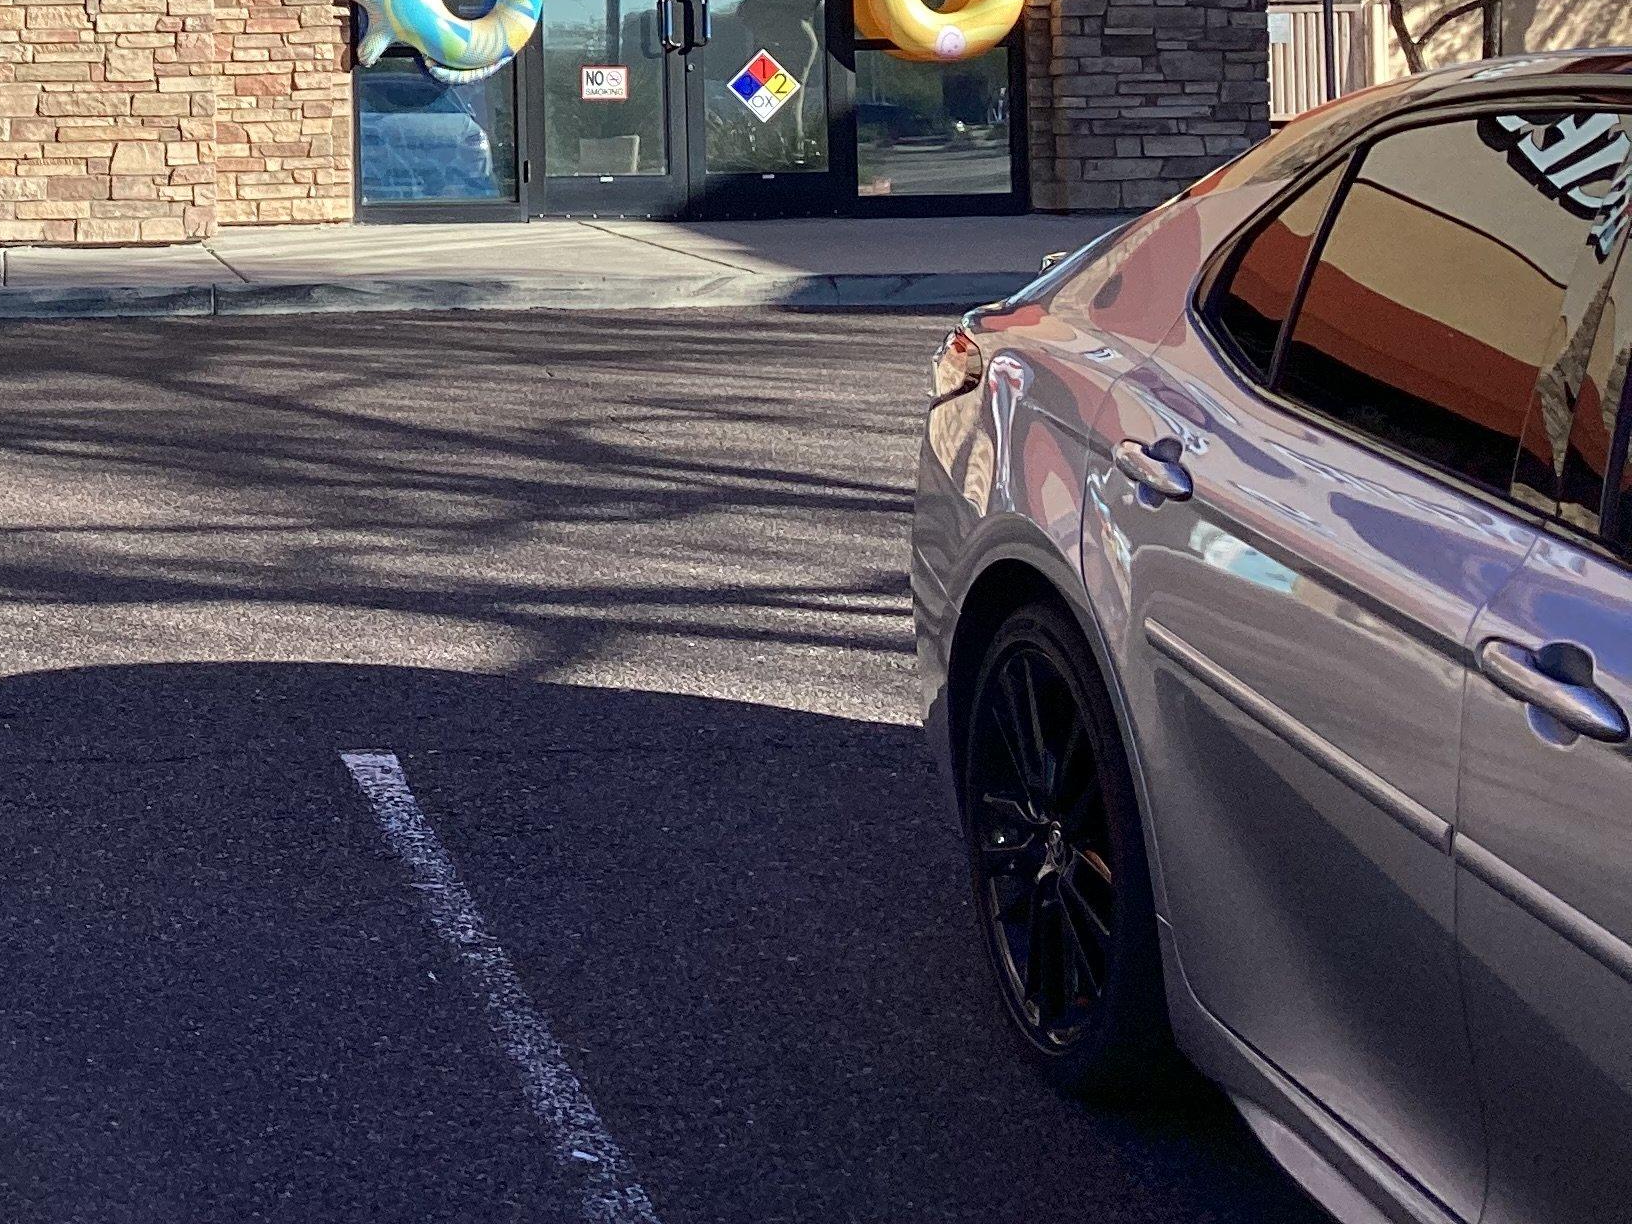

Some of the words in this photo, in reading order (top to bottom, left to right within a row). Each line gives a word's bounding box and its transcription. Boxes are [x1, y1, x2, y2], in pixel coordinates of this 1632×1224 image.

[758, 58, 767, 79] 1
[585, 70, 604, 86] NO
[774, 73, 788, 94] 2
[585, 88, 624, 96] SMOKING
[751, 95, 774, 108] OX
